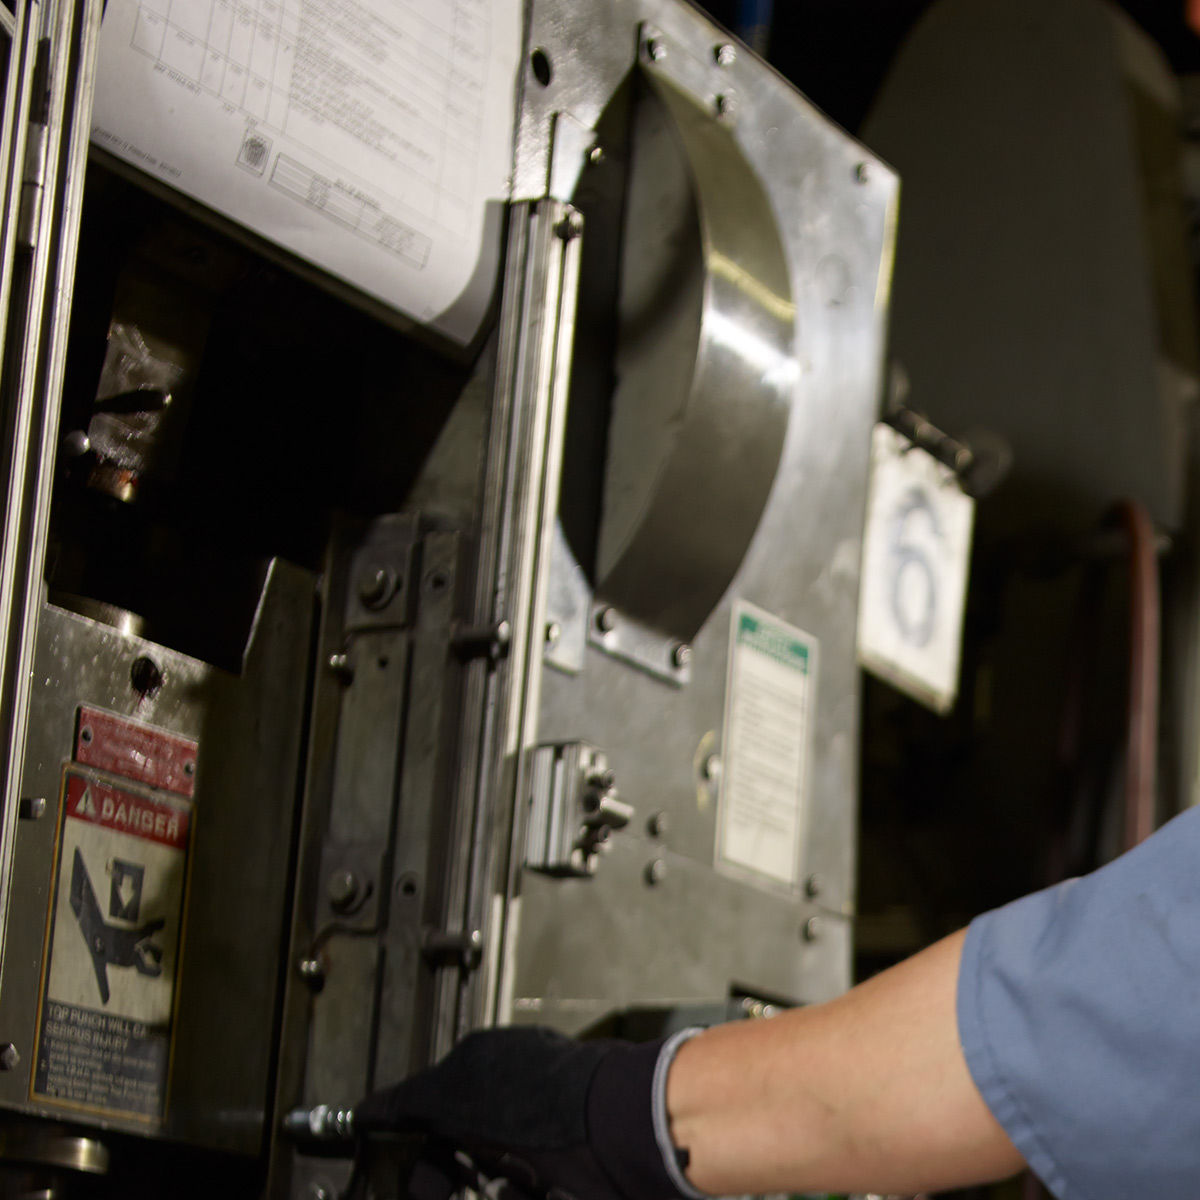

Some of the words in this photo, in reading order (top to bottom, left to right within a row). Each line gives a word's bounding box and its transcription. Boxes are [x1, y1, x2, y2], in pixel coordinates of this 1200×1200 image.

[101, 797, 178, 841] DANGER
[49, 1004, 69, 1021] TOP
[70, 1009, 106, 1031] PUNCH
[46, 1021, 91, 1041] SERIOUS
[93, 1031, 129, 1051] INJURY
